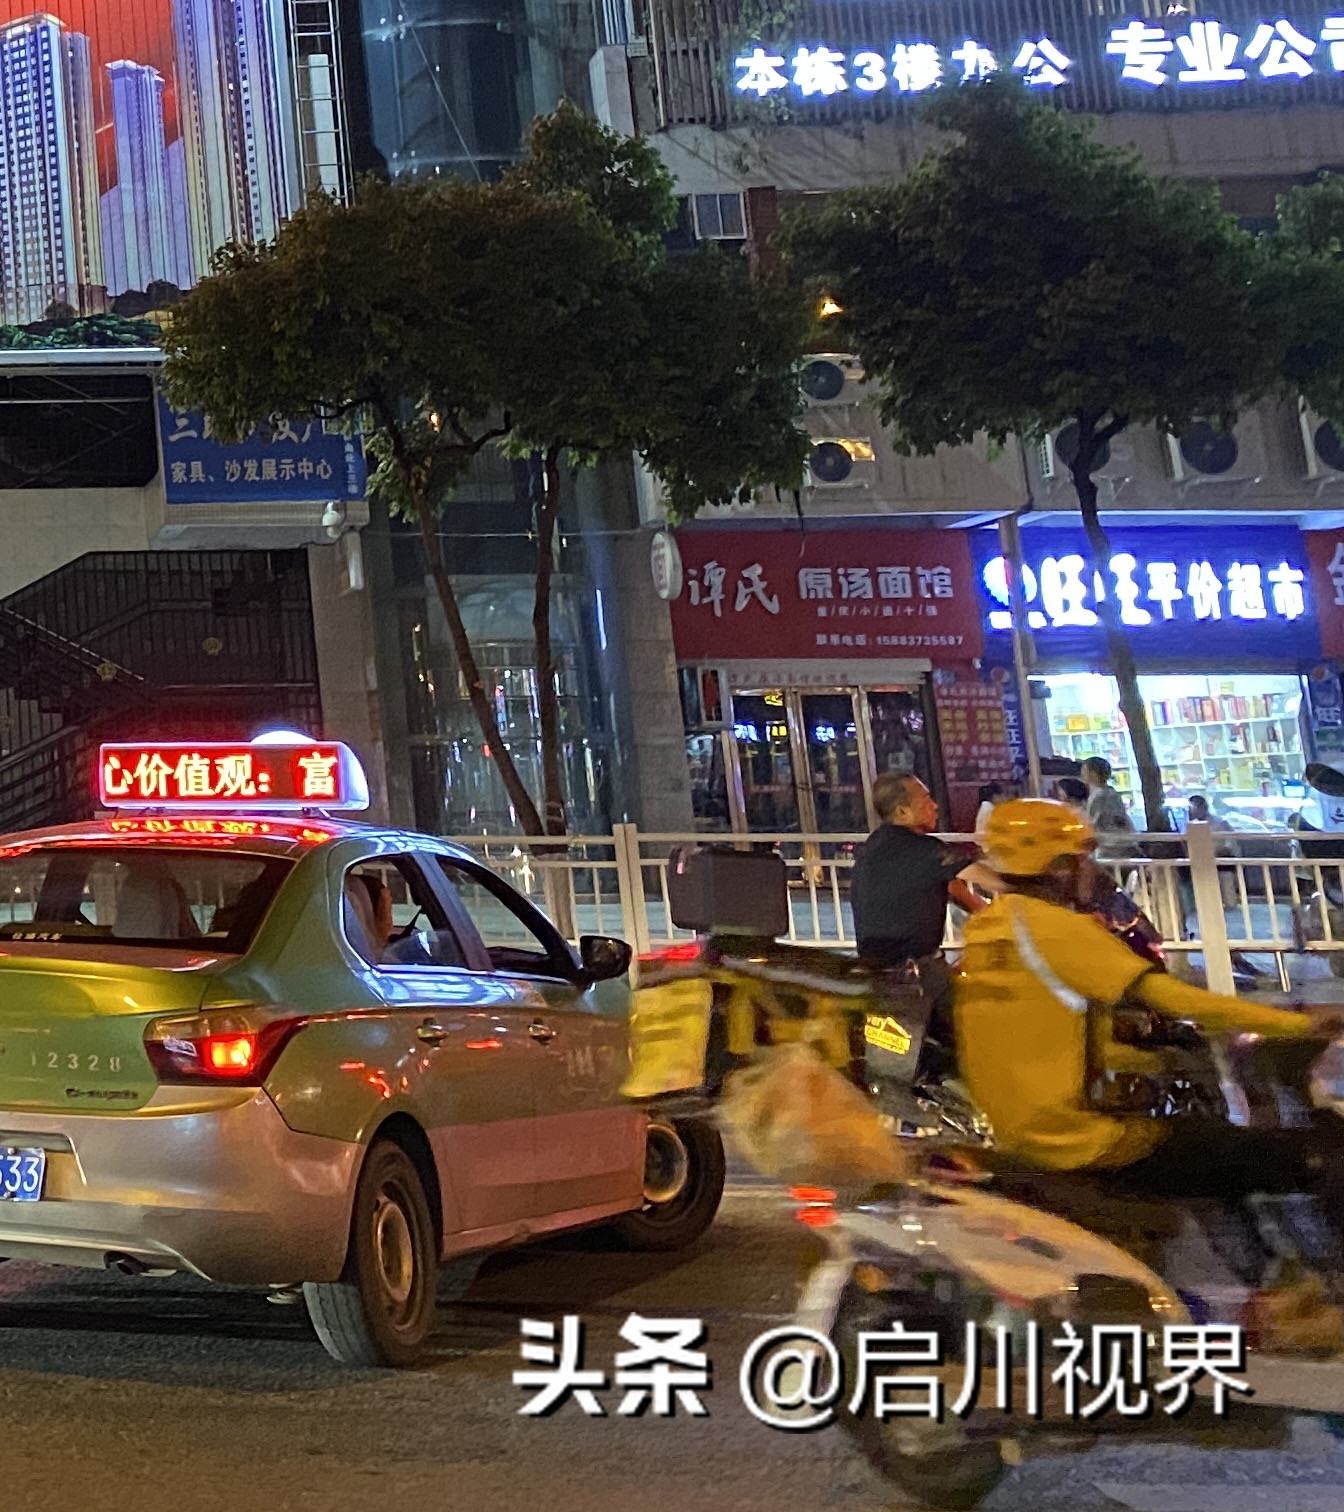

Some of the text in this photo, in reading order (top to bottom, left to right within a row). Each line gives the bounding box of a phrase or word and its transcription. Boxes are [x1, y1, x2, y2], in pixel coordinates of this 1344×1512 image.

[170, 457, 333, 484] 家具、沙发展示中心
[798, 565, 954, 600] 原汤面馆
[297, 751, 338, 798] 富
